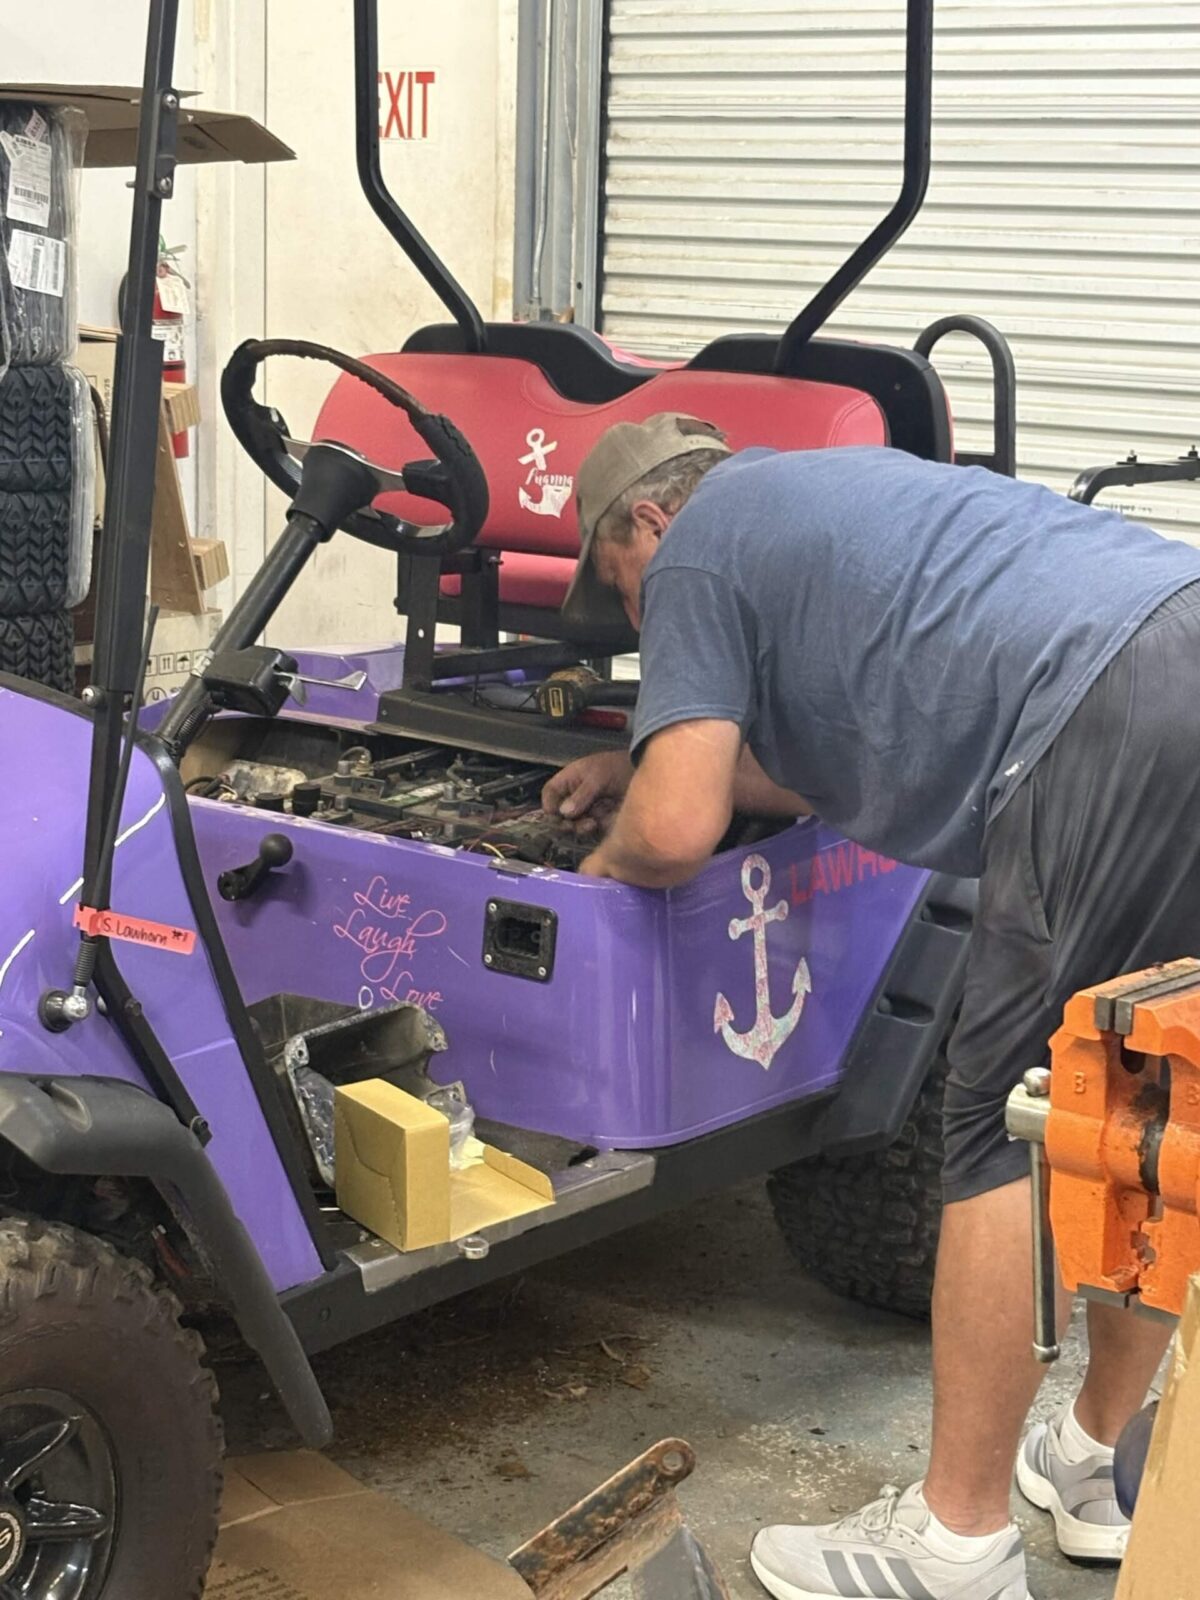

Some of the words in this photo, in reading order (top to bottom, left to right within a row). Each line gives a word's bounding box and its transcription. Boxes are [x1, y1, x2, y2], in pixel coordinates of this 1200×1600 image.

[377, 71, 436, 139] XIT
[353, 875, 412, 919] Live
[333, 908, 447, 983] Laugh
[380, 970, 444, 1010] Love
